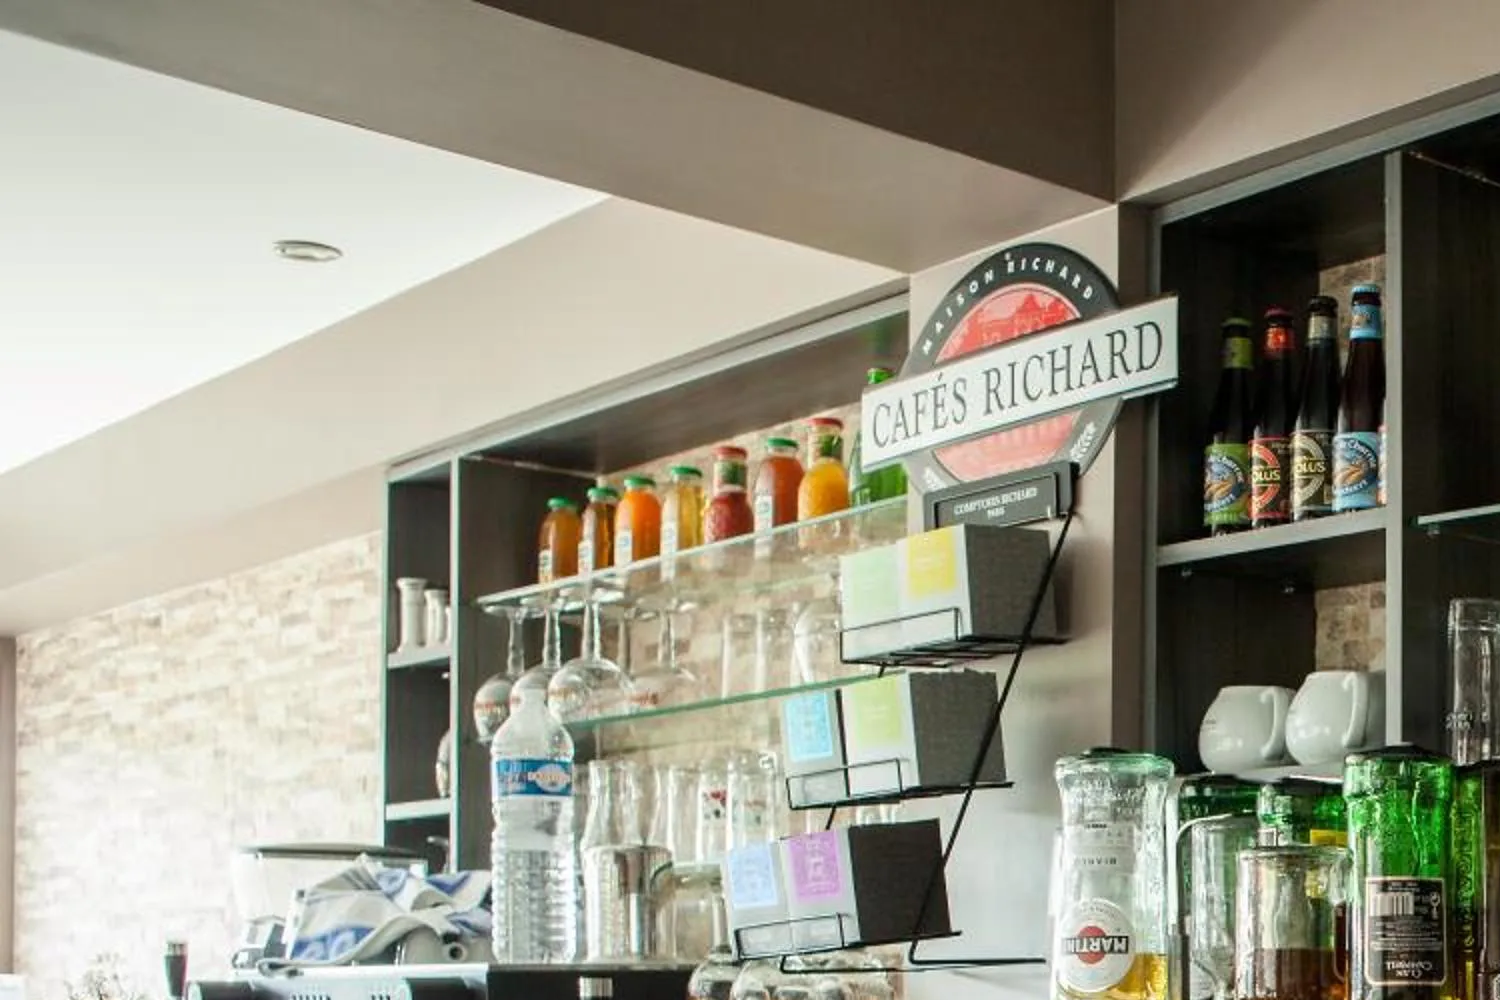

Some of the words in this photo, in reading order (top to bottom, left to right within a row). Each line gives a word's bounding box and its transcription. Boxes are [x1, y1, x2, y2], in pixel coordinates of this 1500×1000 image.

[922, 269, 994, 355] MAISON
[1006, 256, 1093, 300] RICHARD
[872, 371, 968, 449] CAFÉS
[982, 321, 1163, 416] RICHARD
